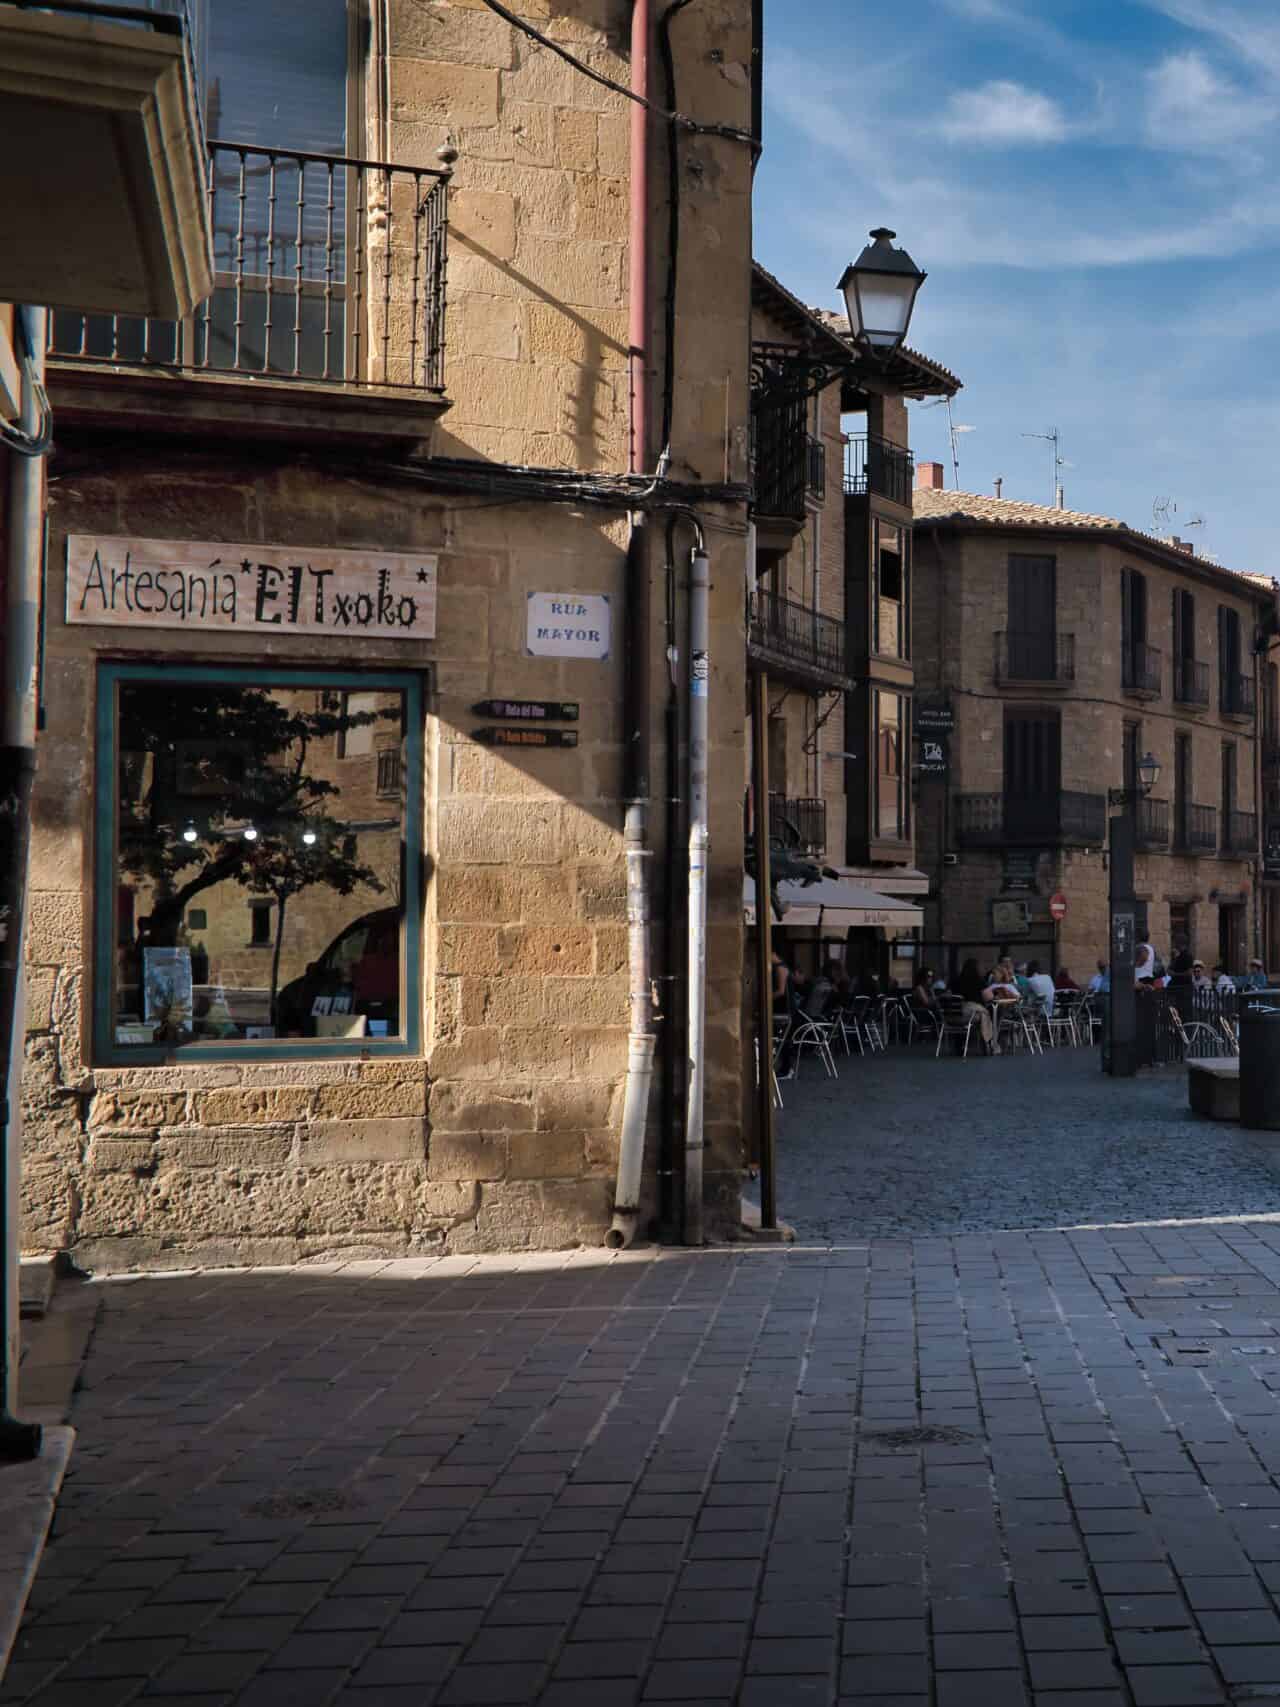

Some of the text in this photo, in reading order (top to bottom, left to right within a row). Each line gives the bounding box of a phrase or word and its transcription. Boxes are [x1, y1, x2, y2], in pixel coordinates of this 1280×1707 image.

[79, 549, 237, 623] Artesanía
[551, 603, 588, 616] RUA
[536, 628, 601, 642] MAYOR
